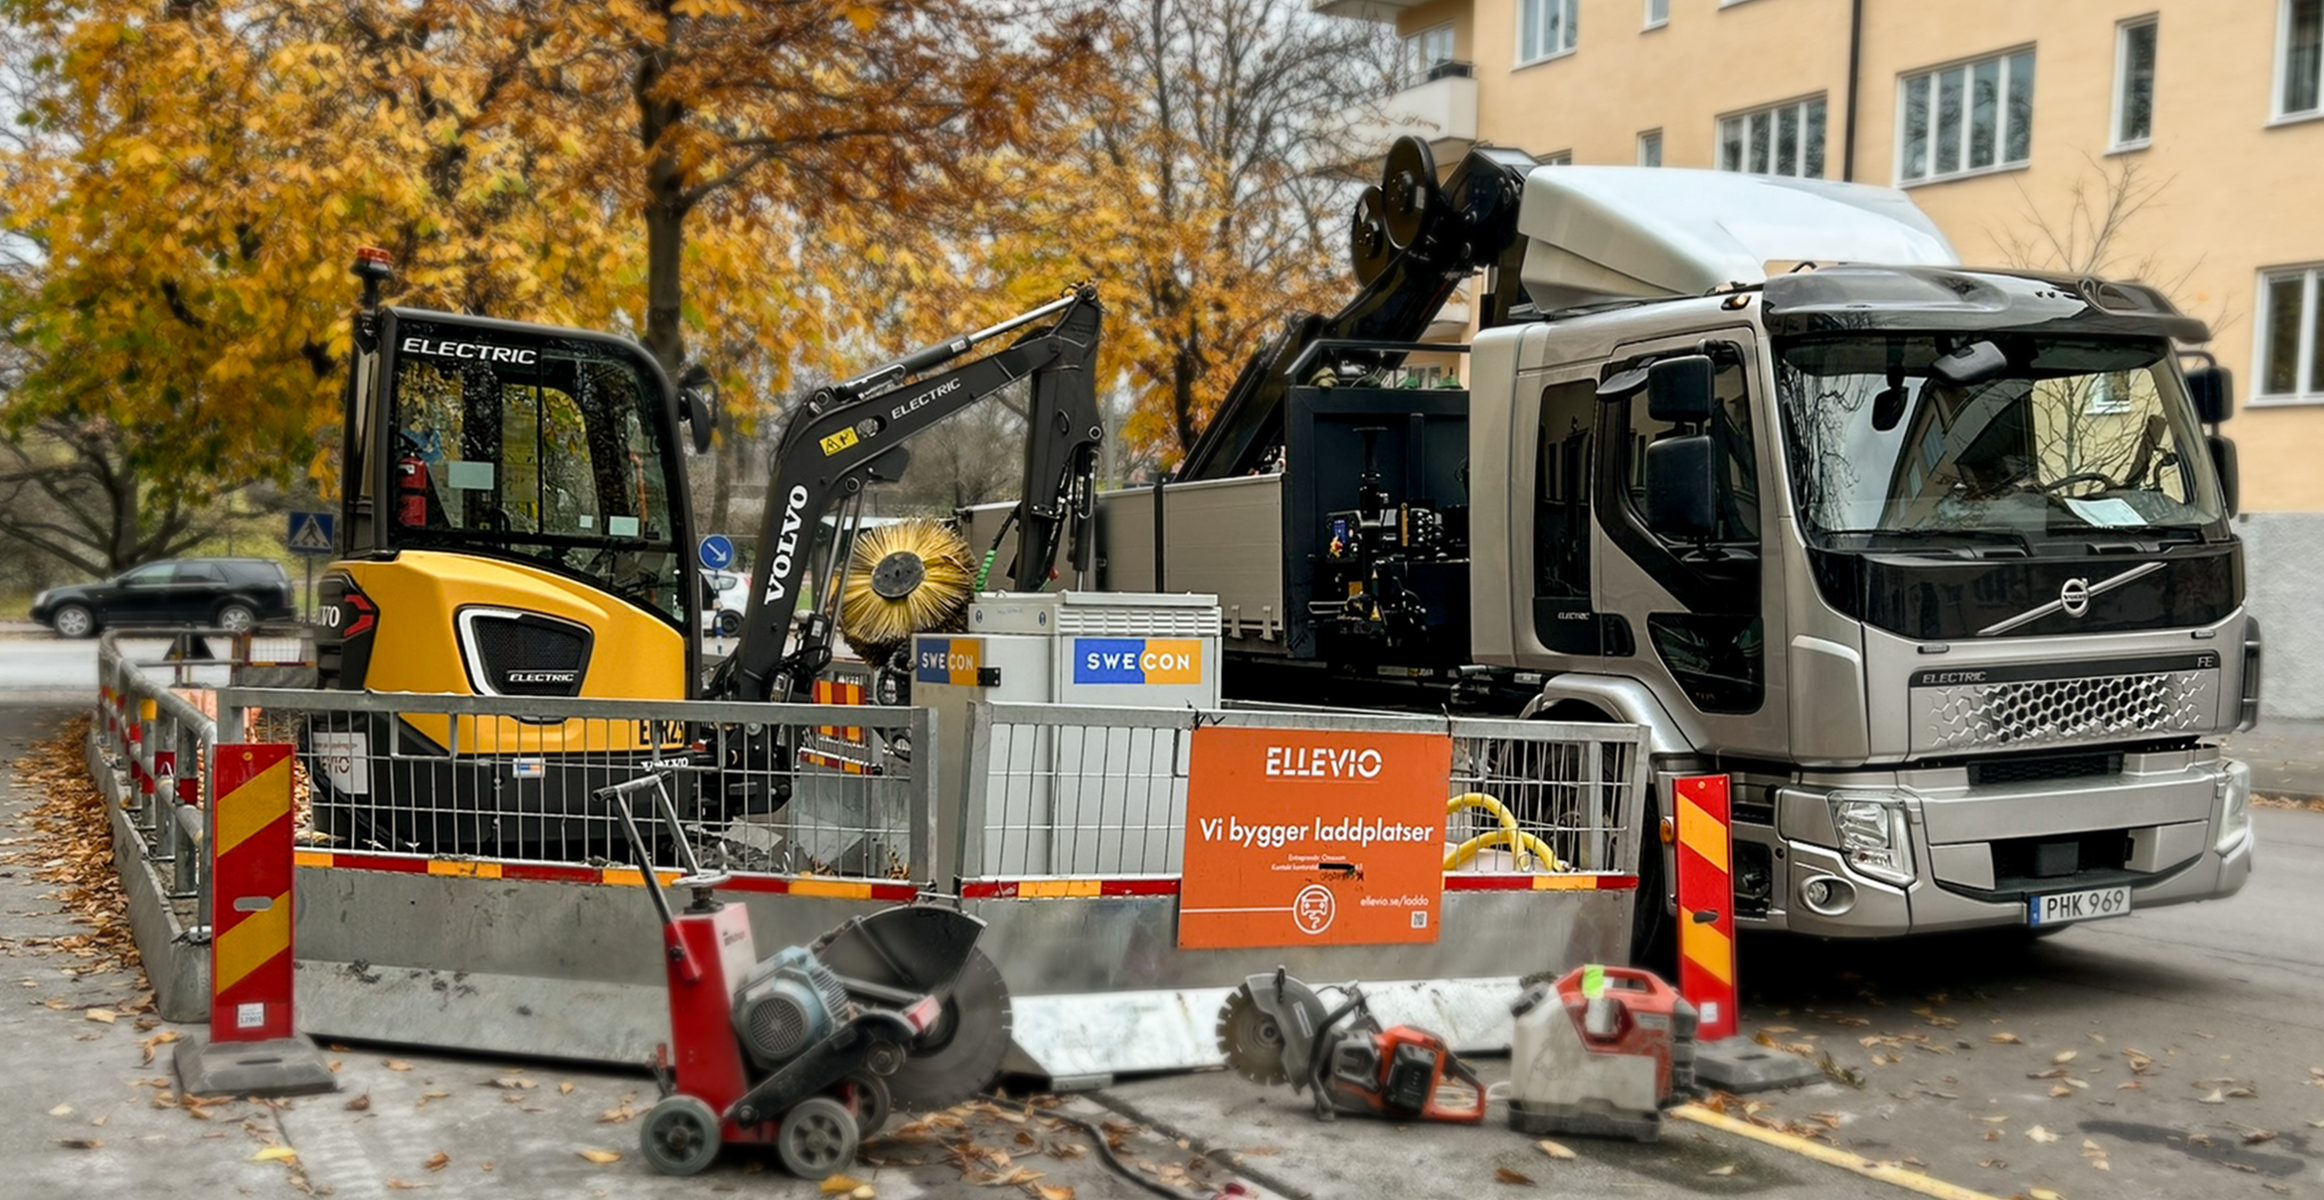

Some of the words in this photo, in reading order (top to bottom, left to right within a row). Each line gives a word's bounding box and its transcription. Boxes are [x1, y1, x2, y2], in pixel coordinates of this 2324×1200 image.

[402, 337, 537, 365] ELECTRIC
[891, 377, 961, 420] ELECTRIC
[763, 484, 808, 606] VOLVO
[921, 651, 974, 671] SWECON
[1087, 652, 1190, 670] SWECON
[2197, 656, 2214, 668] FE
[508, 673, 575, 682] ELECTRIC
[1922, 671, 1987, 684] ELECTRIC
[1266, 746, 1383, 778] ELLEVIO
[1199, 818, 1223, 841] Vi
[1229, 816, 1309, 848] bygger
[1314, 817, 1434, 848] laddplatser
[2047, 893, 2083, 919] PHK
[2089, 889, 2124, 915] 969
